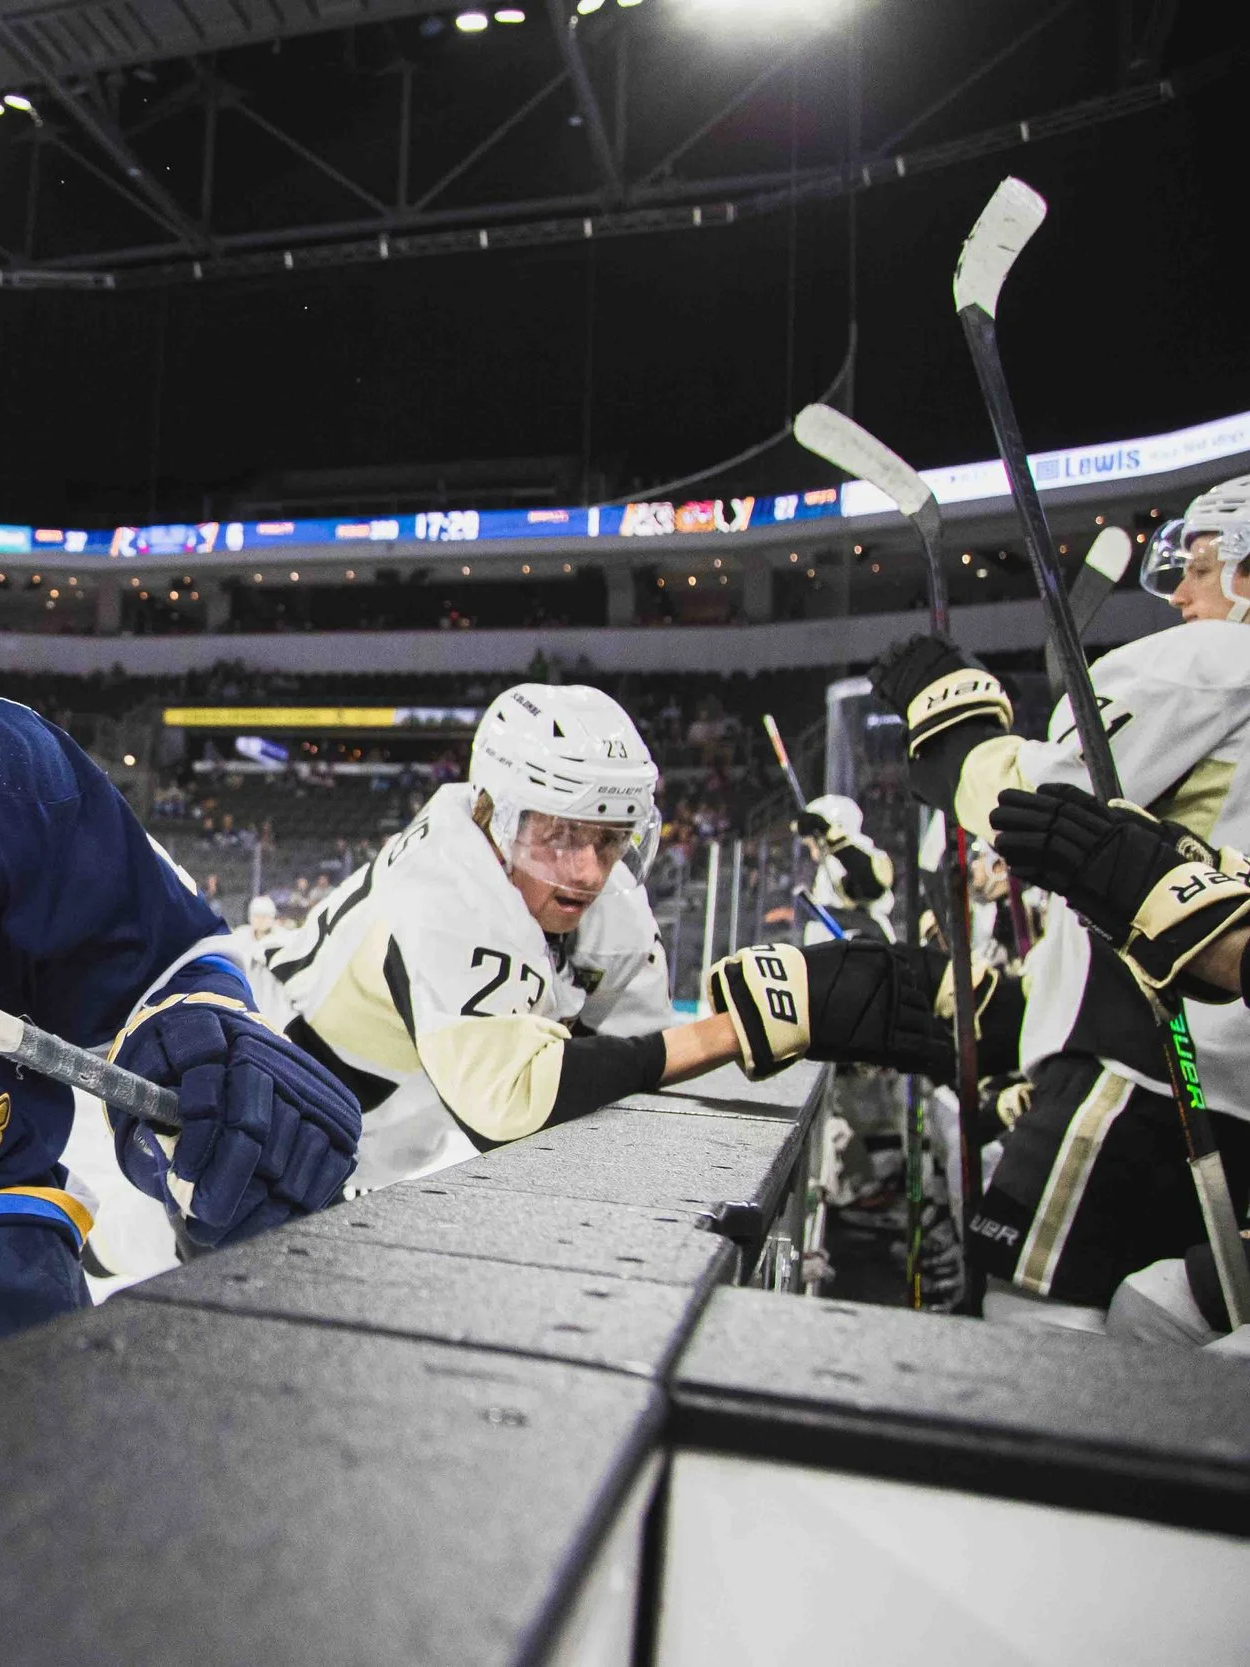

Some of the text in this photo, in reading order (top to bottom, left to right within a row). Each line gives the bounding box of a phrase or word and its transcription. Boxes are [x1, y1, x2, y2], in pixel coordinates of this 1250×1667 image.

[603, 739, 629, 759] 23
[598, 786, 643, 796] BAUER
[459, 946, 546, 1018] 23
[968, 1212, 1020, 1248] UER
